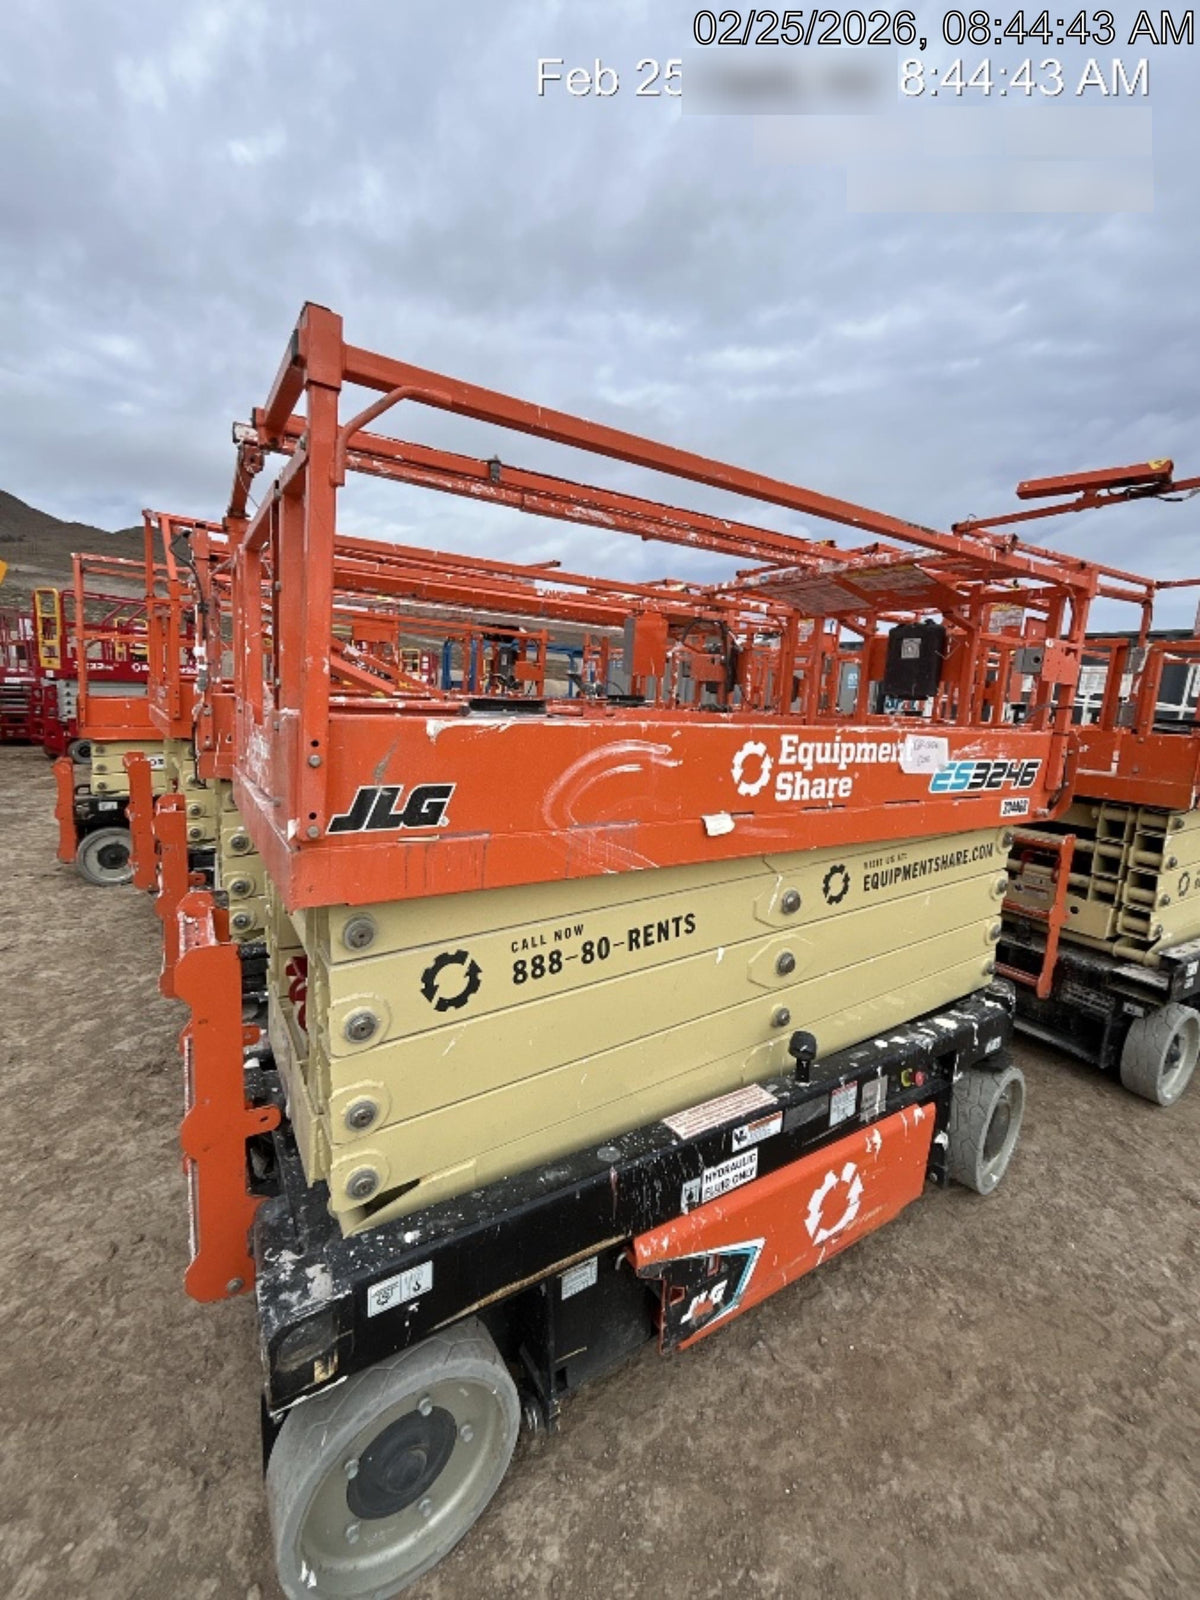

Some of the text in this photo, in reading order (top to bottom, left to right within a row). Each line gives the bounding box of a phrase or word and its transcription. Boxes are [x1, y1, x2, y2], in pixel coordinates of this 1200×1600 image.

[775, 771, 853, 802] Share
[930, 759, 1042, 794] ES3246
[325, 783, 457, 834] JLG
[863, 843, 993, 891] EQUIPMENTSHARE.COM
[511, 924, 584, 953] CALL NOW
[512, 913, 696, 985] 888-80-RENTS
